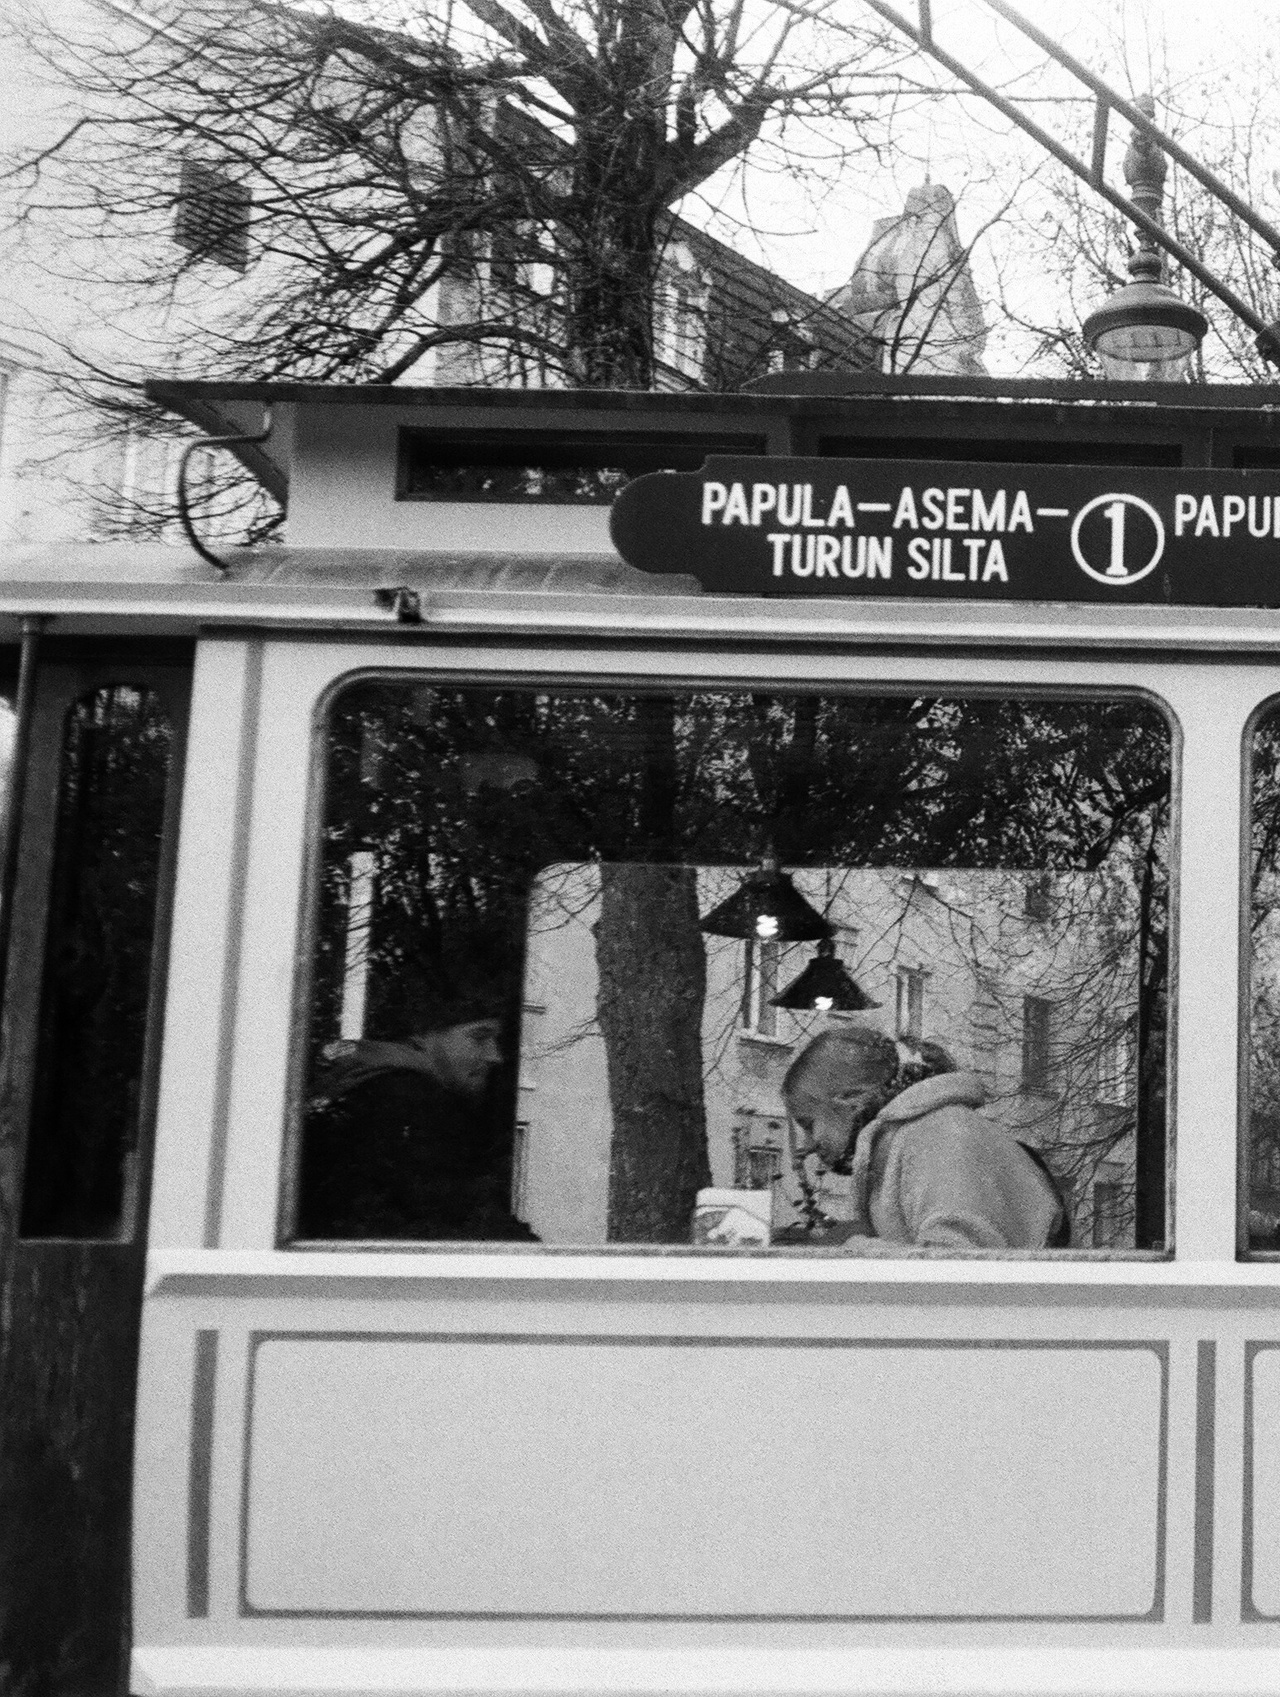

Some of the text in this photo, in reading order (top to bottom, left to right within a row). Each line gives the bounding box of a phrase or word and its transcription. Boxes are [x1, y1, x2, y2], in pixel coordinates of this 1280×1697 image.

[766, 533, 1009, 582] TURUN SILTA
[1105, 502, 1129, 577] 1
